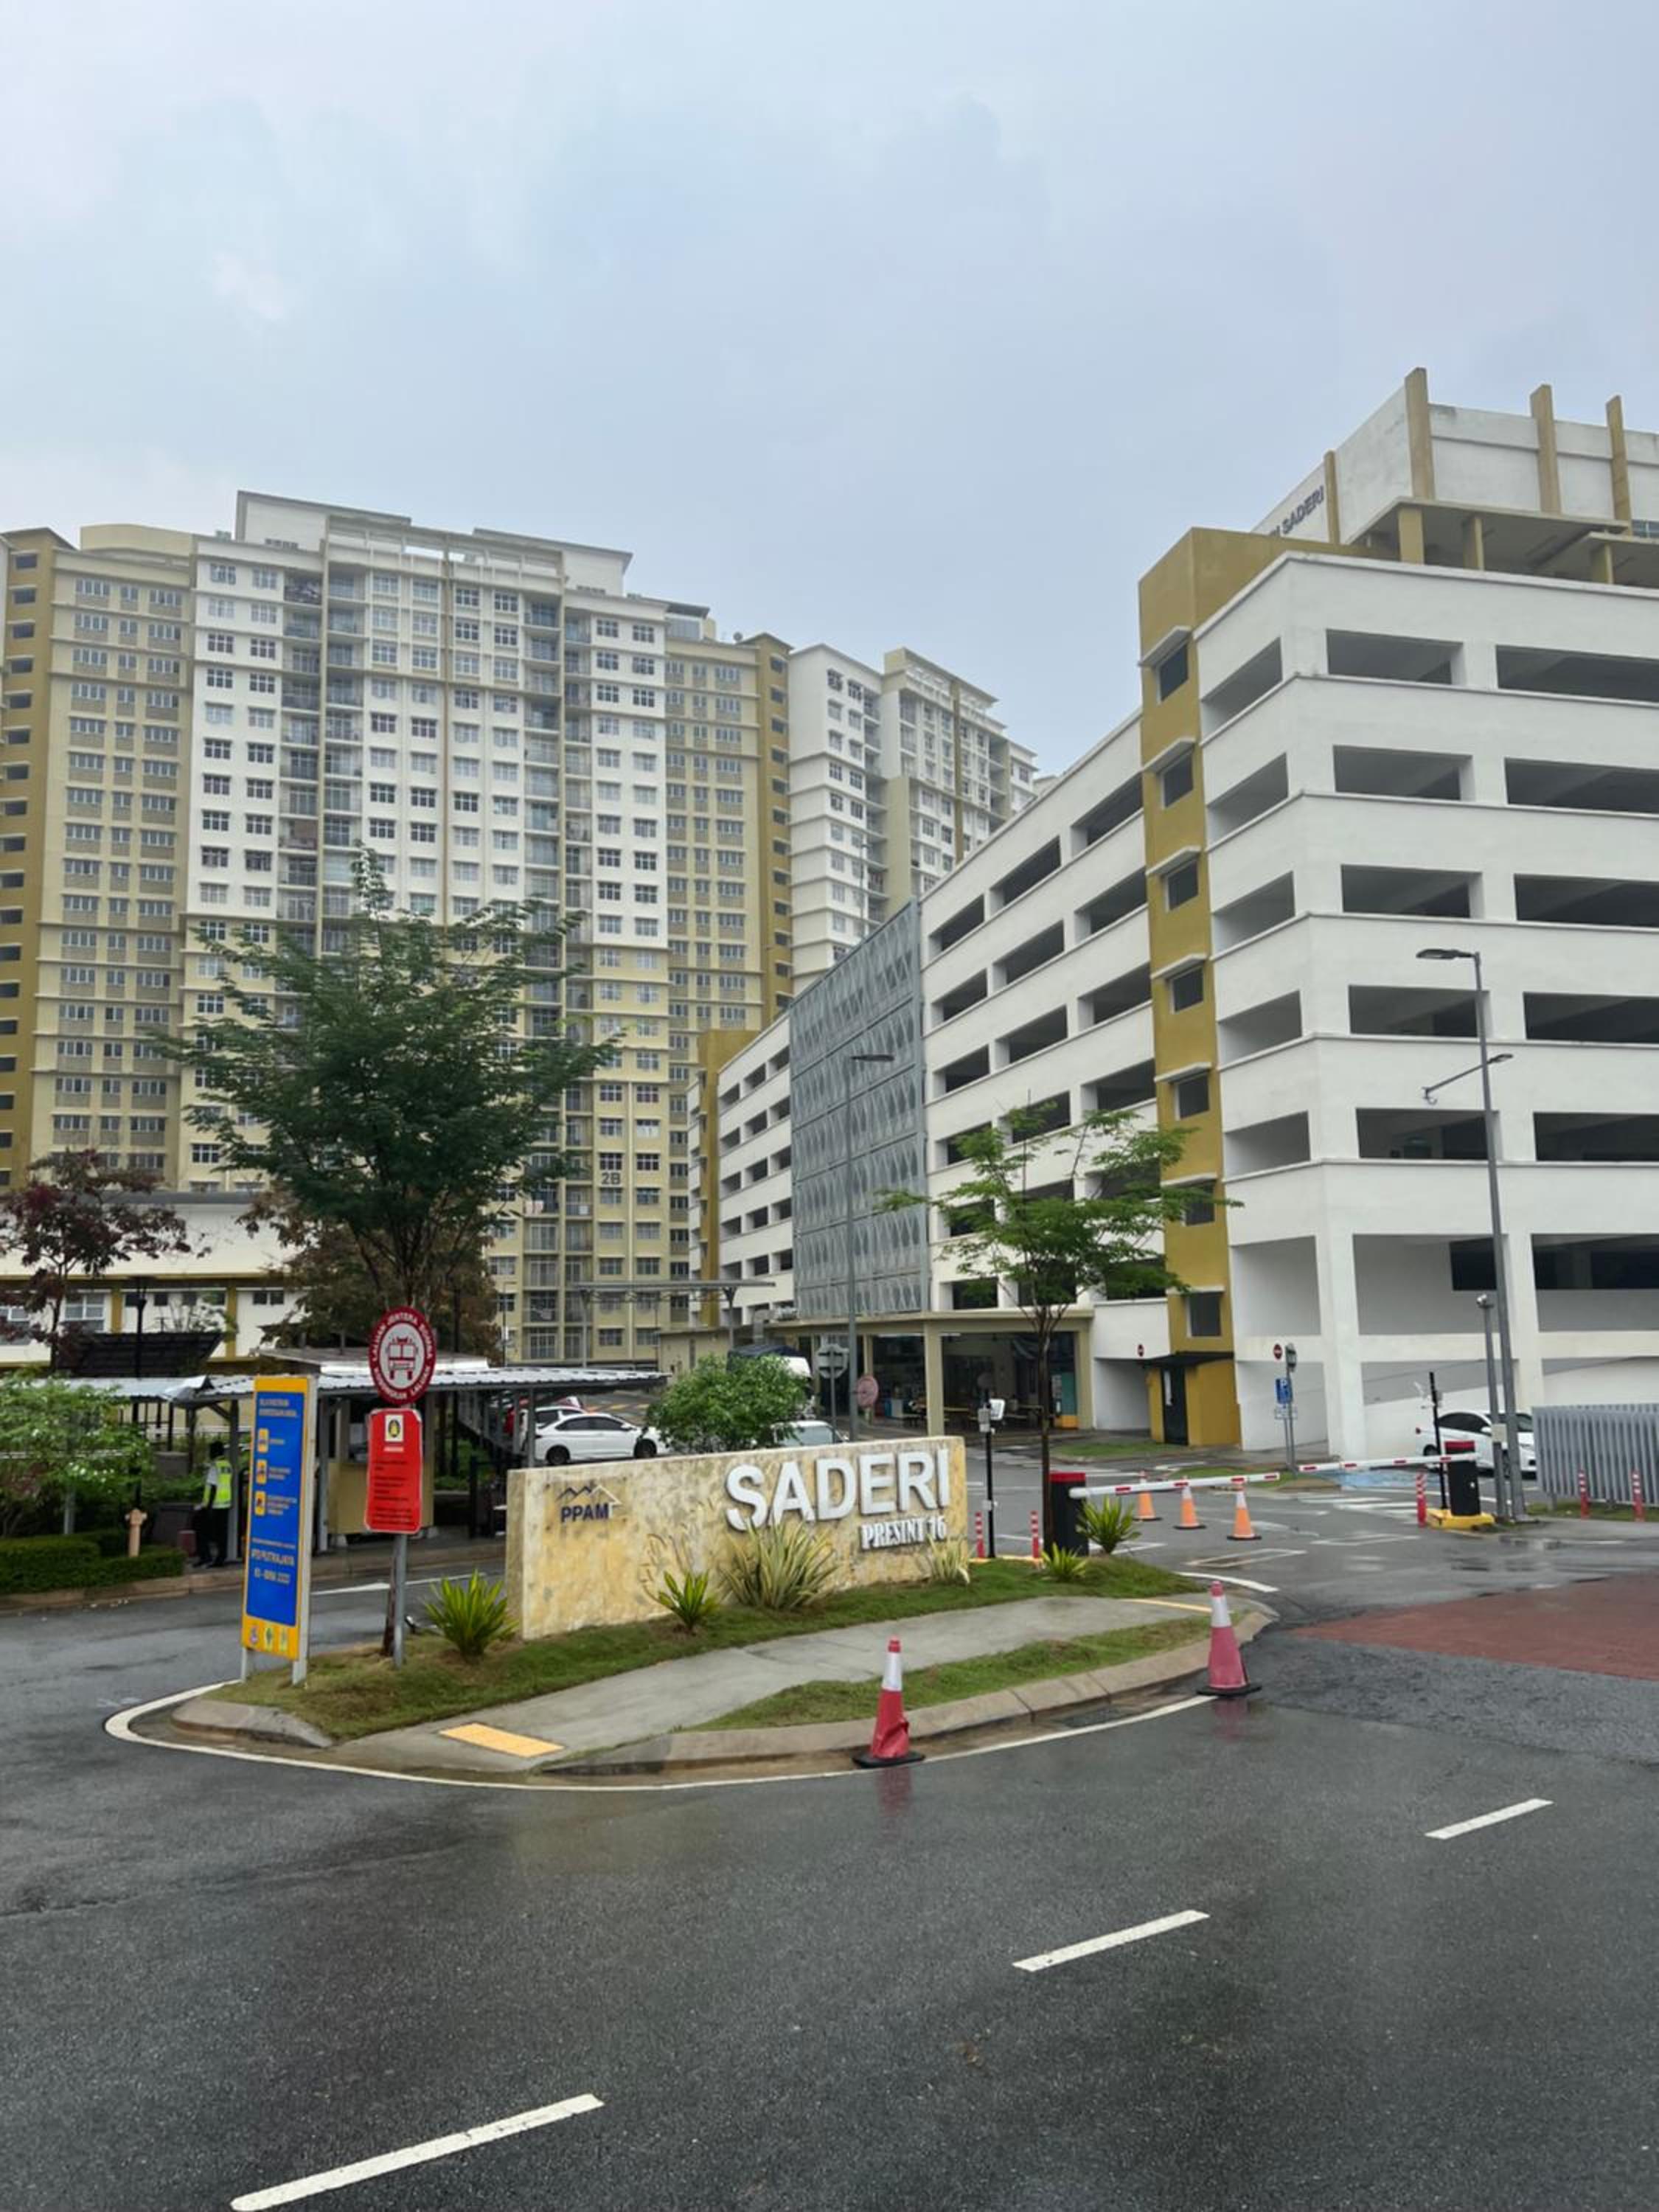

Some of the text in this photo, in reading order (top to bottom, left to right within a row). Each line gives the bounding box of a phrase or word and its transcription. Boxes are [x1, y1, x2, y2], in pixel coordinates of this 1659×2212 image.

[1281, 484, 1324, 535] SADERI
[726, 1449, 950, 1531] SADERI
[560, 1502, 609, 1523] PPAM
[860, 1514, 947, 1550] PRESINT 16
